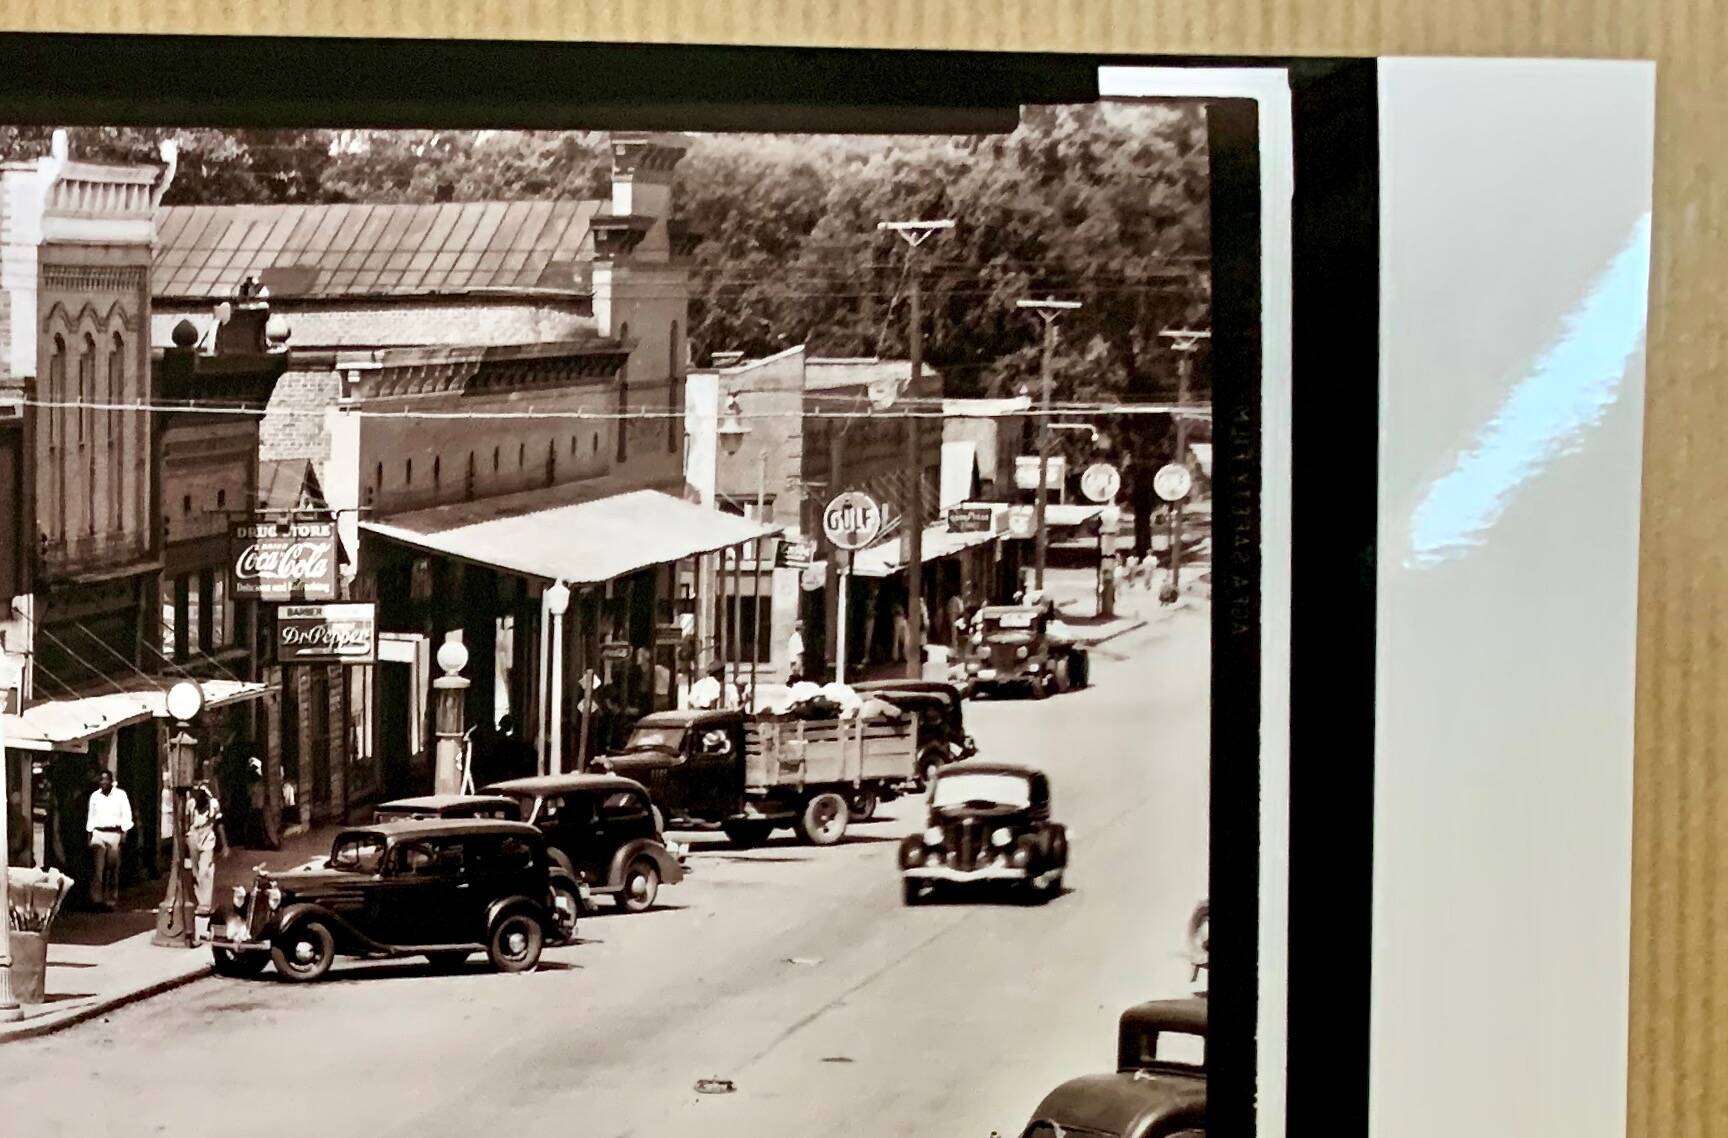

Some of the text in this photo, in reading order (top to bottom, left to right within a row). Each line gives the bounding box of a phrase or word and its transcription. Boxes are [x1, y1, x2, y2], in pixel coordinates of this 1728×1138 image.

[827, 504, 873, 530] GULF
[237, 525, 277, 538] DRUG
[287, 607, 322, 617] BARBER
